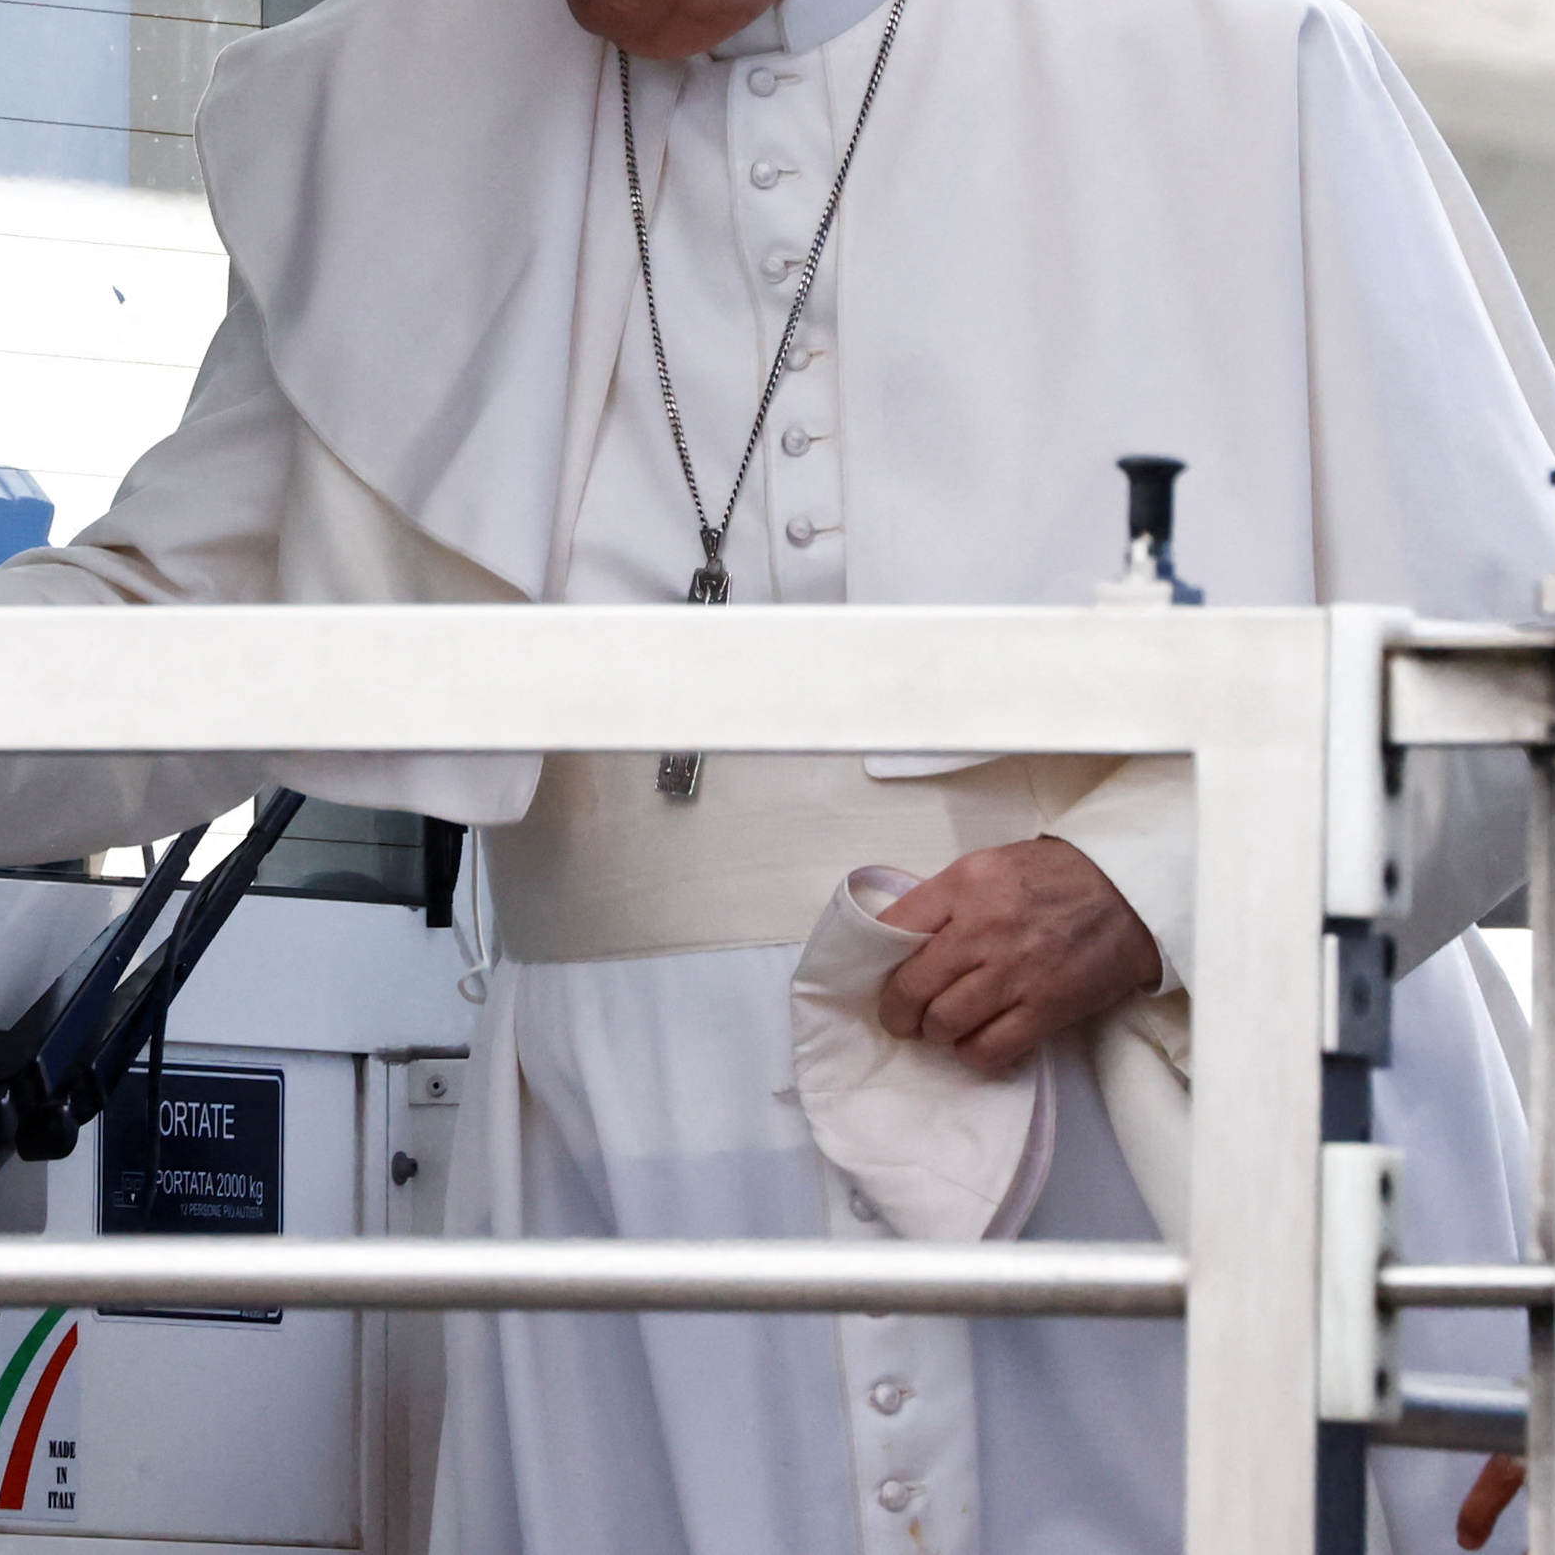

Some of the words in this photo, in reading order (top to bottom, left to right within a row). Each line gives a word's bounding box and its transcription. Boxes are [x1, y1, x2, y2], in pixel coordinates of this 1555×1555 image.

[159, 1100, 235, 1139] ORTATE
[216, 1173, 246, 1198] 2000
[249, 1175, 264, 1205] kg
[189, 1203, 222, 1218] PERSONE
[49, 1440, 76, 1459] MADE
[57, 1466, 67, 1484] IN
[48, 1491, 76, 1510] ITALY
